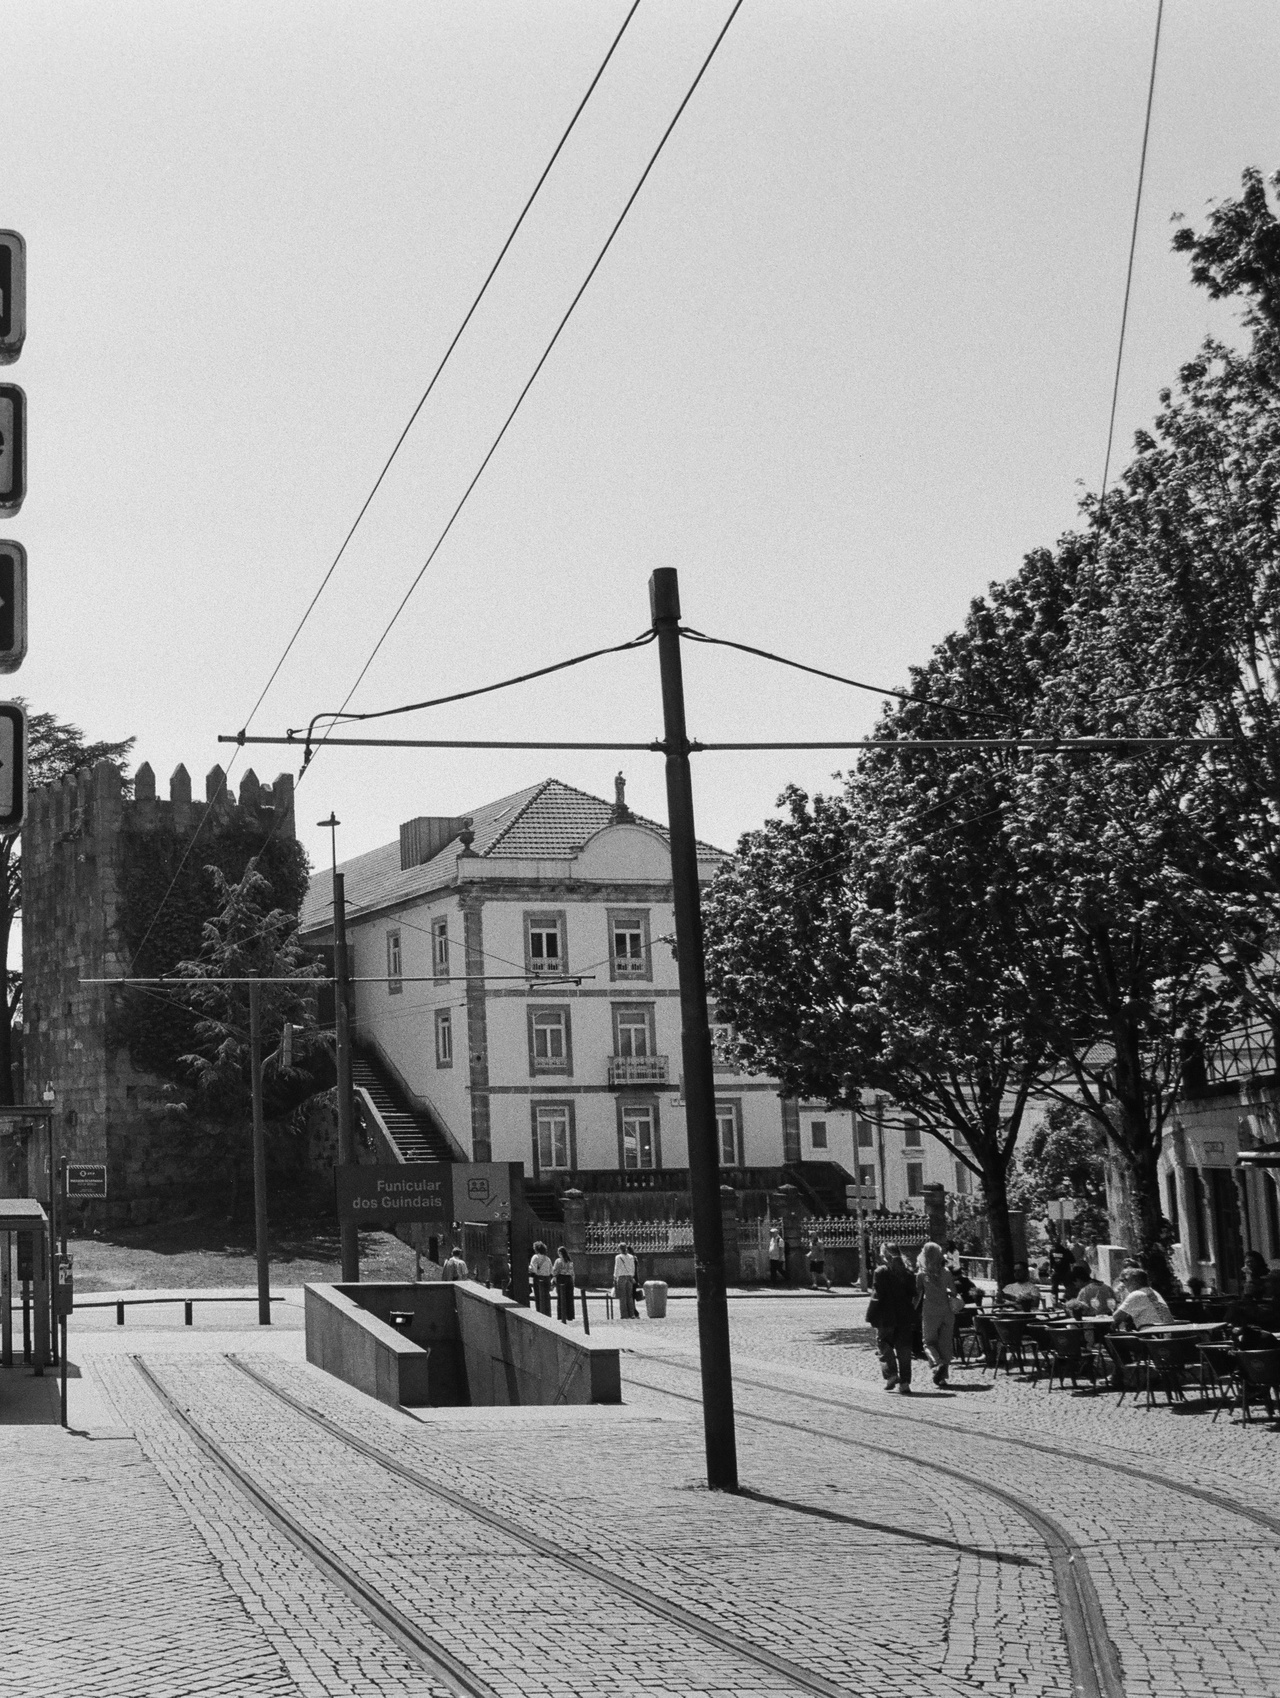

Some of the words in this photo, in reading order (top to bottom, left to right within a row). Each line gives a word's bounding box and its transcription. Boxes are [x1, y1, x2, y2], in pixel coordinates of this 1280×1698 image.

[376, 1179, 442, 1192] Funicular
[352, 1197, 378, 1209] dos
[381, 1195, 442, 1208] Guindais
